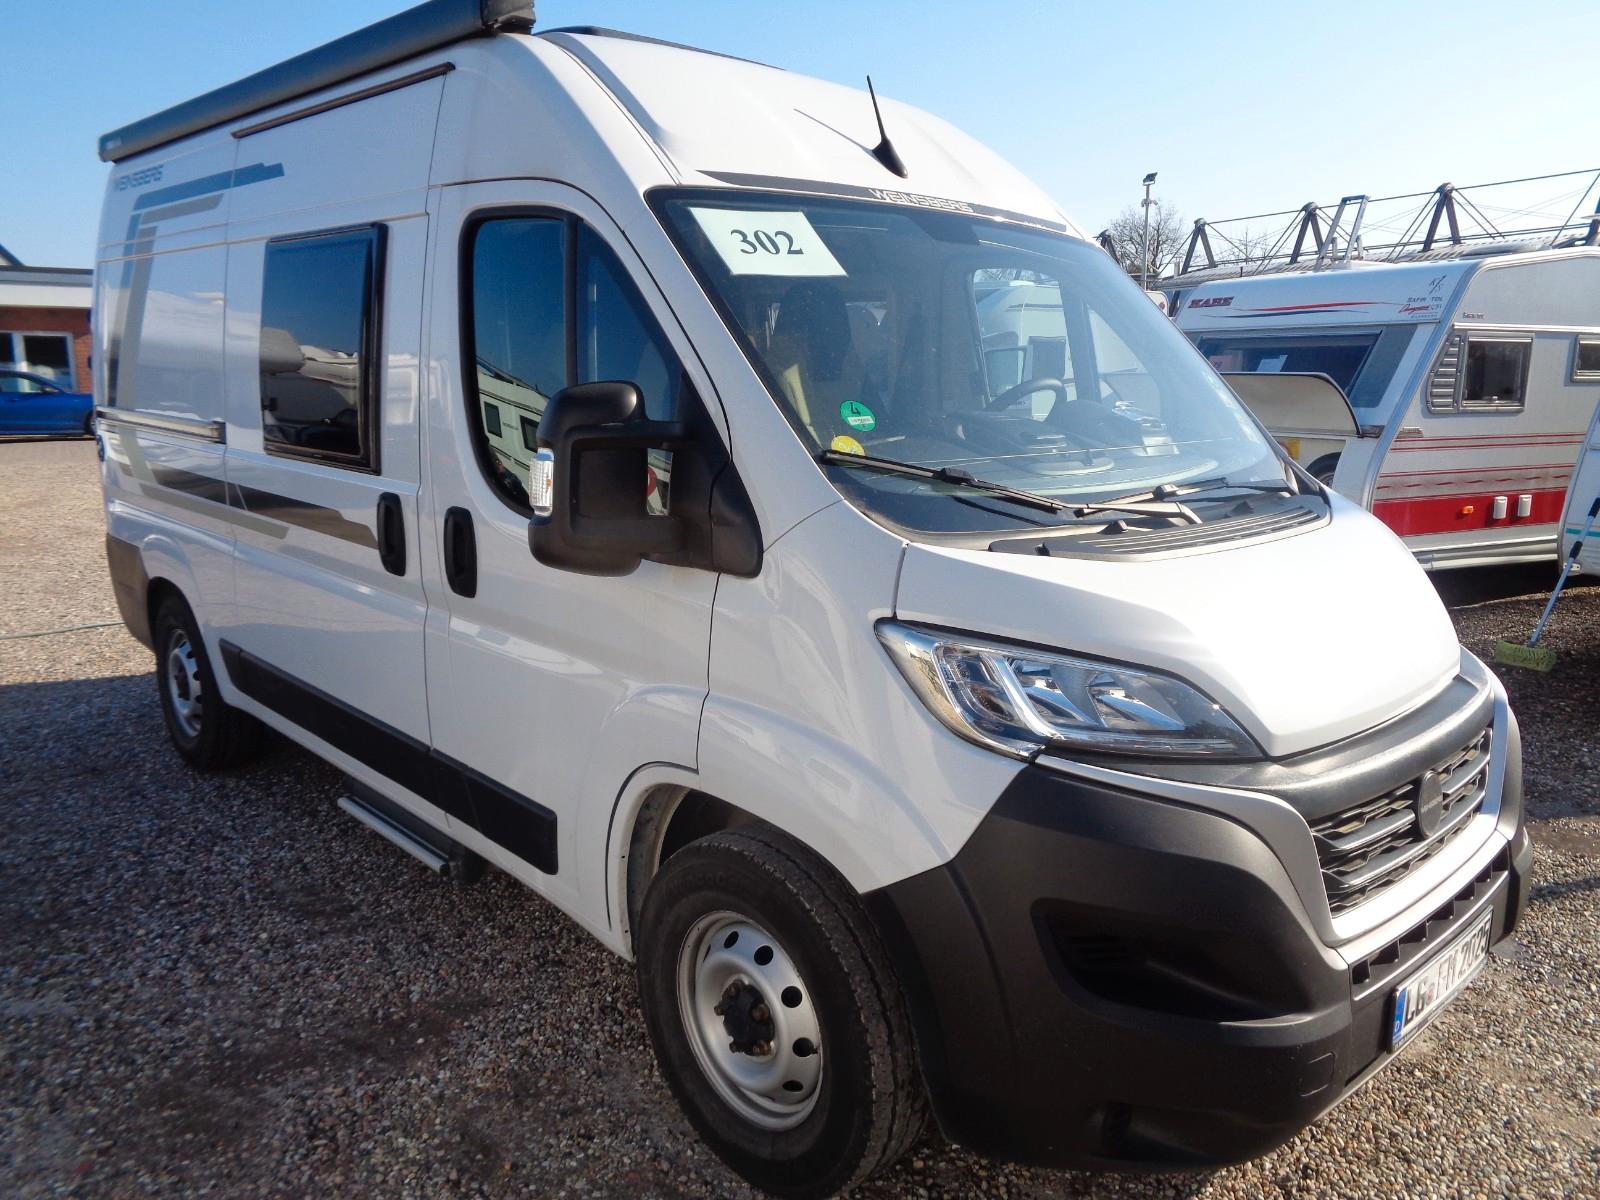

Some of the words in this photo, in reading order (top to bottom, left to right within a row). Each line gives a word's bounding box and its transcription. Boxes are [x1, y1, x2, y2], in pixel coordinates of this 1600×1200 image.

[868, 188, 974, 213] WEINSBERG
[730, 228, 804, 255] 302
[850, 402, 861, 415] 4
